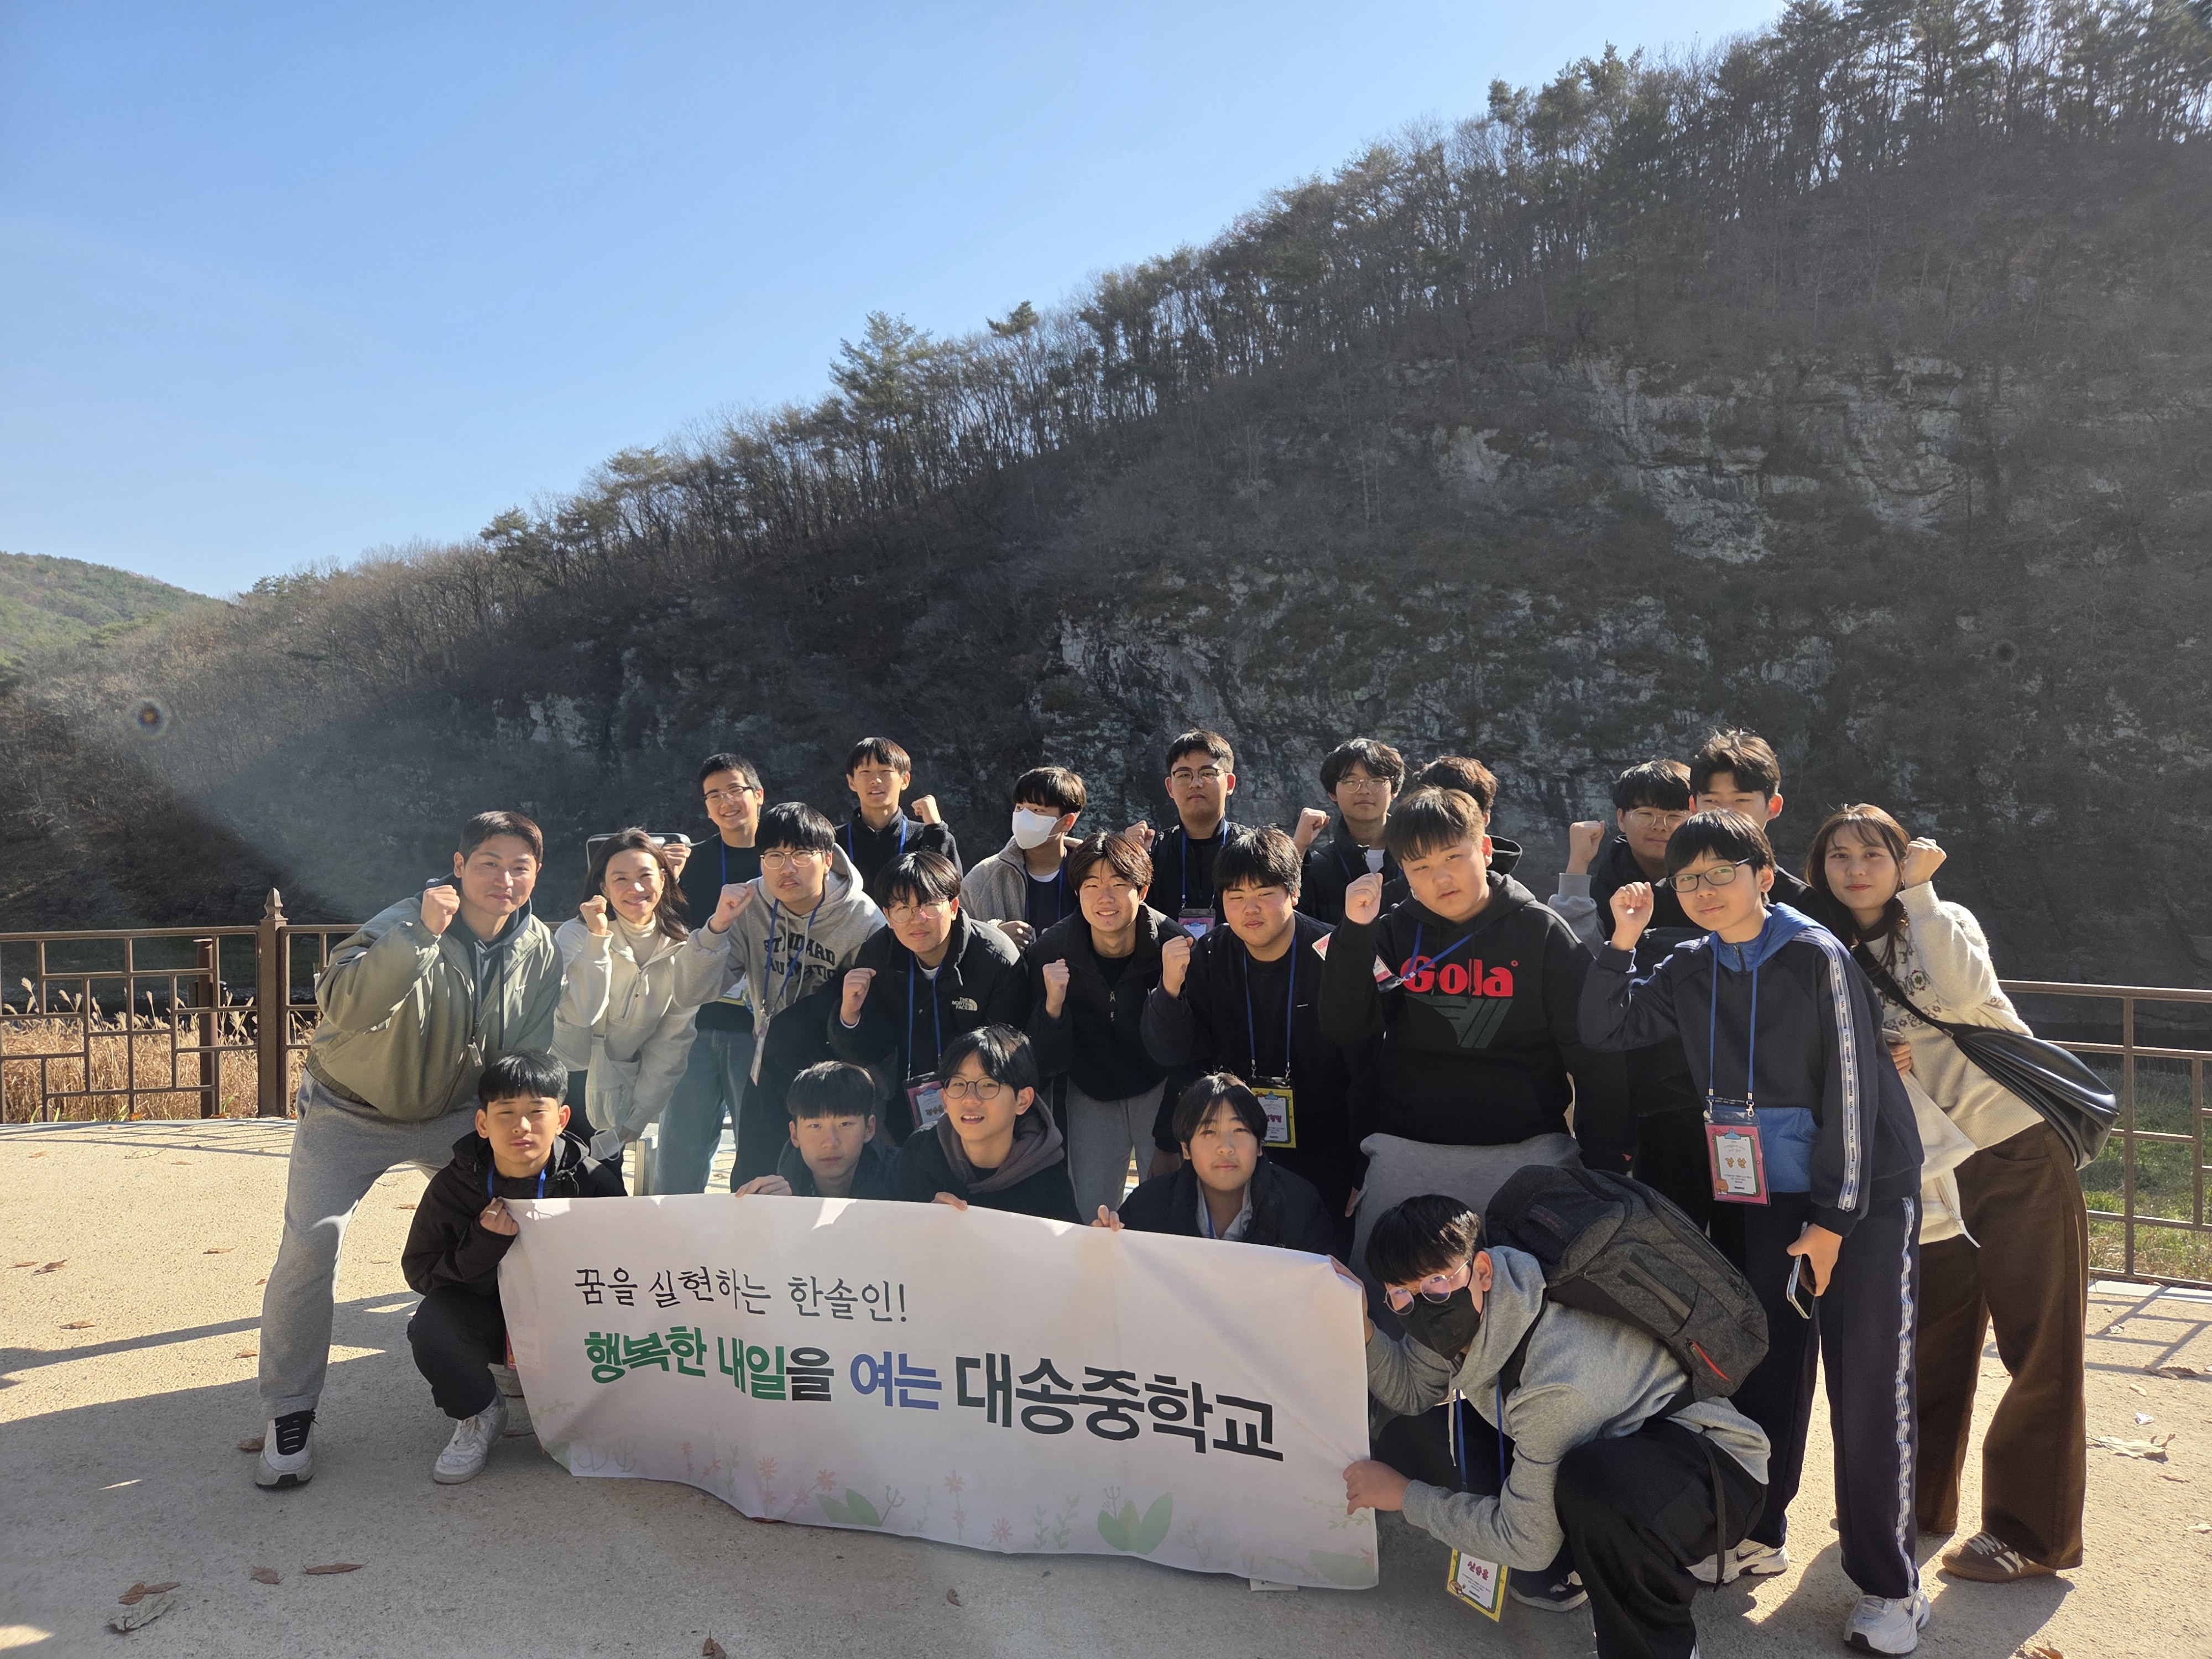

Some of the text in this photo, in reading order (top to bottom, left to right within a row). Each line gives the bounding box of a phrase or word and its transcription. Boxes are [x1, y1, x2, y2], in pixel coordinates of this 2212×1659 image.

[764, 933, 836, 967] STNDARD
[1400, 955, 1513, 997] Gola
[573, 1266, 907, 1322] 꿈을 실현하는 한솔인!
[583, 1326, 1284, 1462] 행복한 내일을 여는 대송중학교
